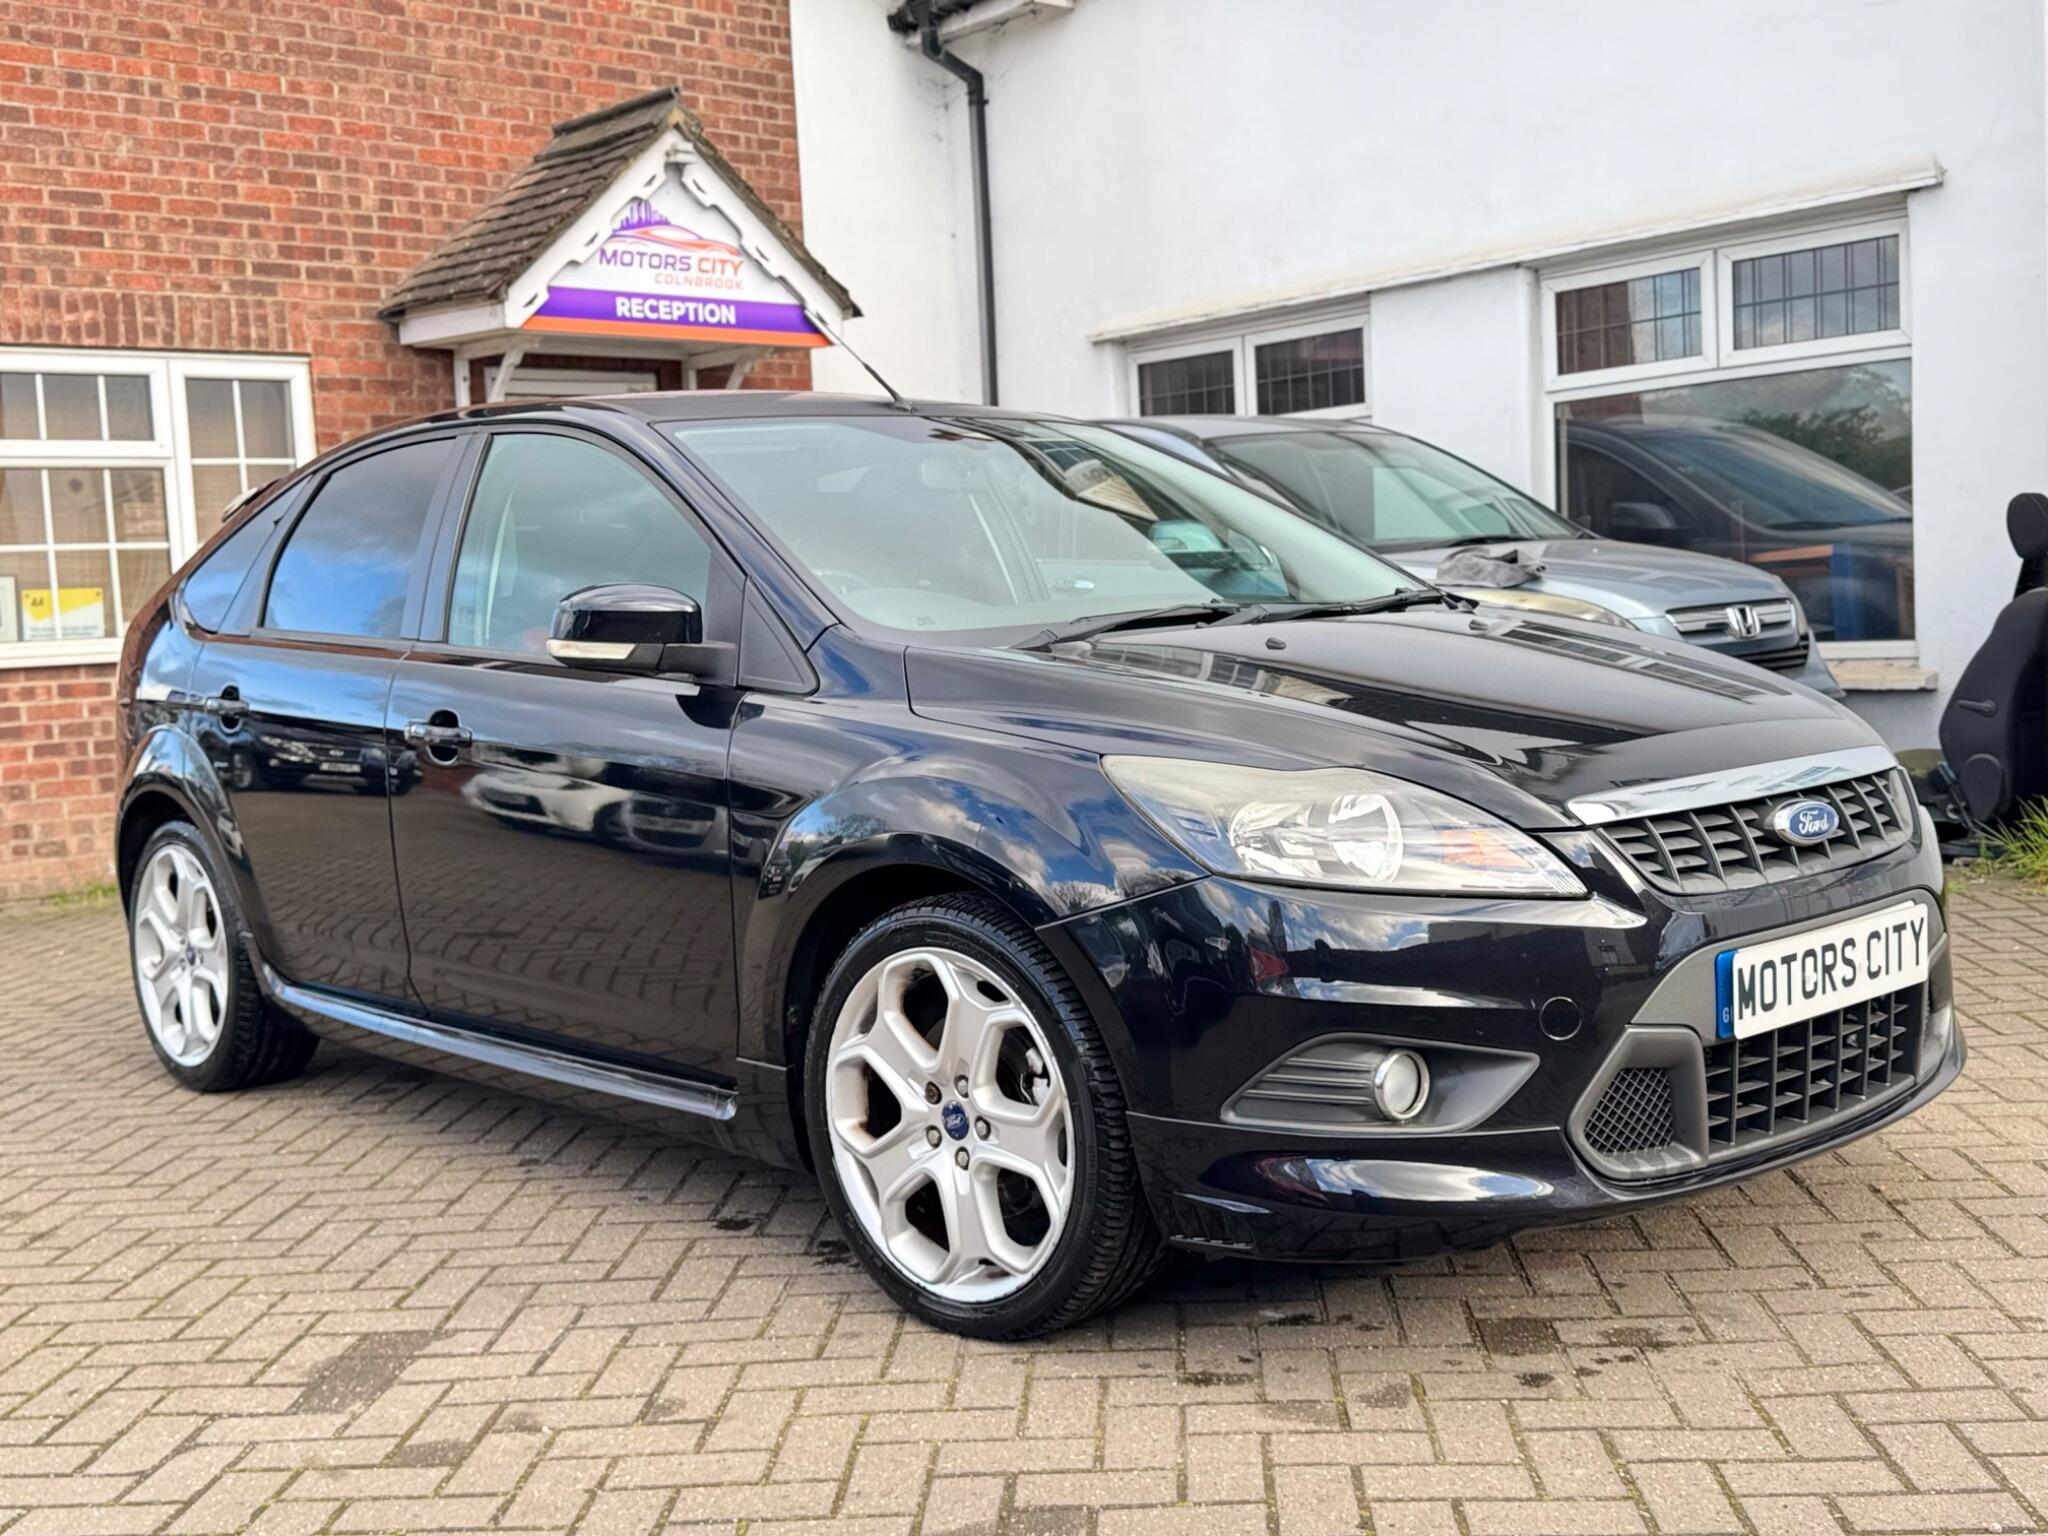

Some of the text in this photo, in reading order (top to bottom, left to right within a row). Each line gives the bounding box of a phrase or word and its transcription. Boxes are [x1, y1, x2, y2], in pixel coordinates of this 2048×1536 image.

[600, 249, 743, 276] MOTORS CITY
[655, 273, 743, 290] COLNBROOK
[615, 296, 736, 325] RECEPTION
[1799, 809, 1829, 834] Ford
[1737, 916, 1925, 1020] MOTORS CITY
